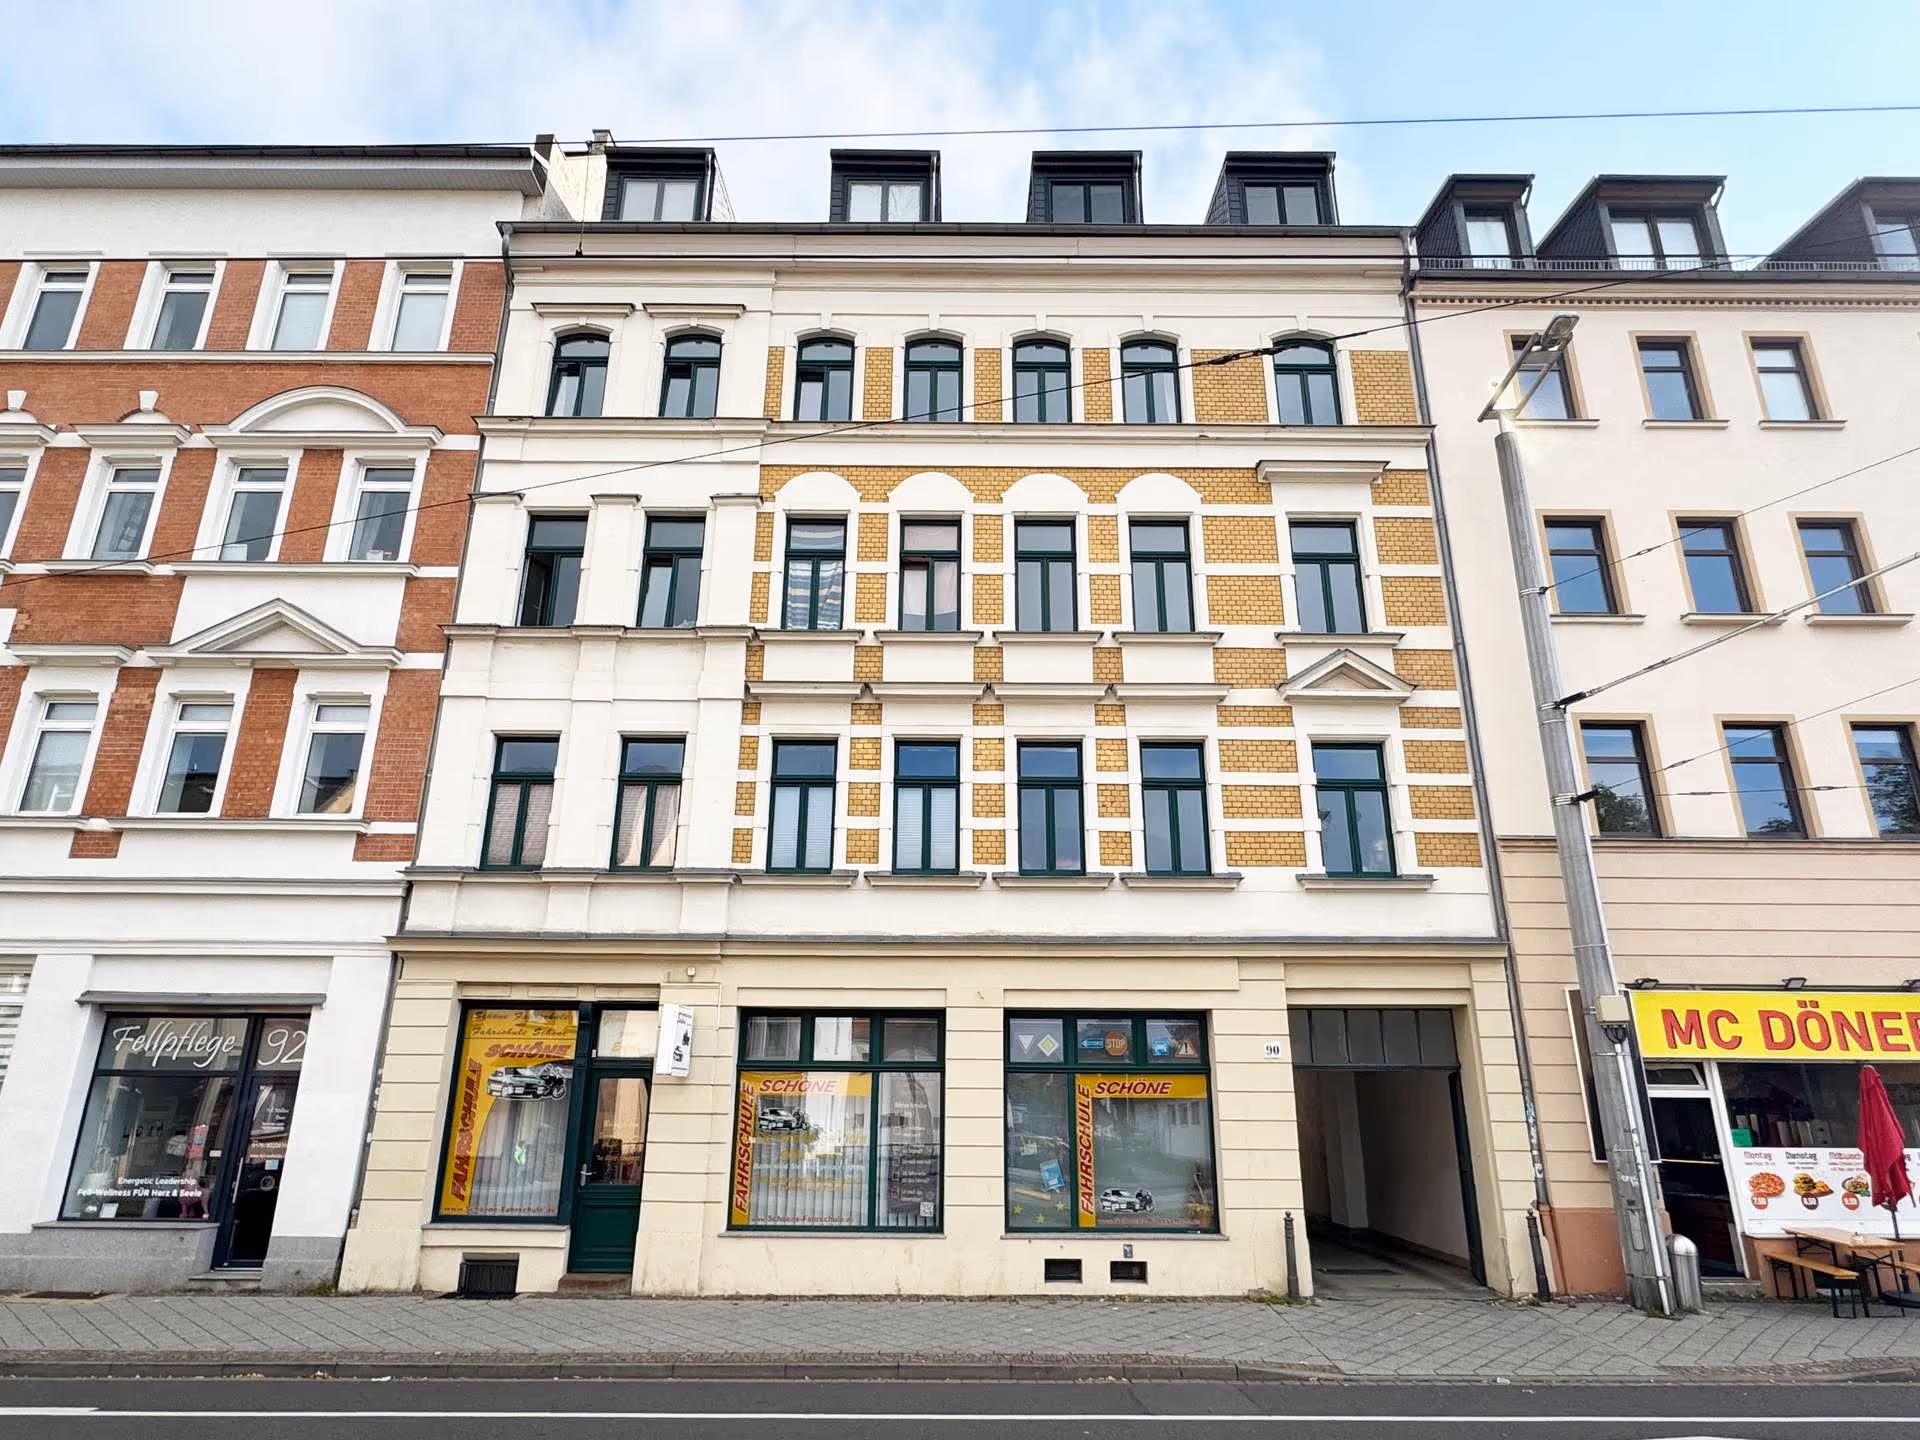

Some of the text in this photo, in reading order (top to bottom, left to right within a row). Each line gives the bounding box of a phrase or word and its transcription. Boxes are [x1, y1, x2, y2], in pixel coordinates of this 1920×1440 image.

[1661, 1009, 1743, 1050] MC
[113, 1021, 307, 1068] Fellpflege 92
[485, 1041, 572, 1058] SCHÖNE
[1106, 1038, 1126, 1049] STOP
[1265, 1044, 1280, 1056] 90
[1095, 1078, 1172, 1095] SCHÖNE
[451, 1058, 482, 1202] FAHRSCHULE
[735, 1082, 754, 1213] FAHRSCHULE
[1077, 1084, 1094, 1215] FAHRSCHULE
[1744, 1151, 1772, 1161] Montag
[1785, 1151, 1818, 1161] Dienstag
[117, 1177, 197, 1189] Energetic Leadership
[133, 1187, 150, 1197] FÜR
[151, 1189, 170, 1197] Herz
[171, 1189, 178, 1197] &
[179, 1189, 202, 1198] Seele
